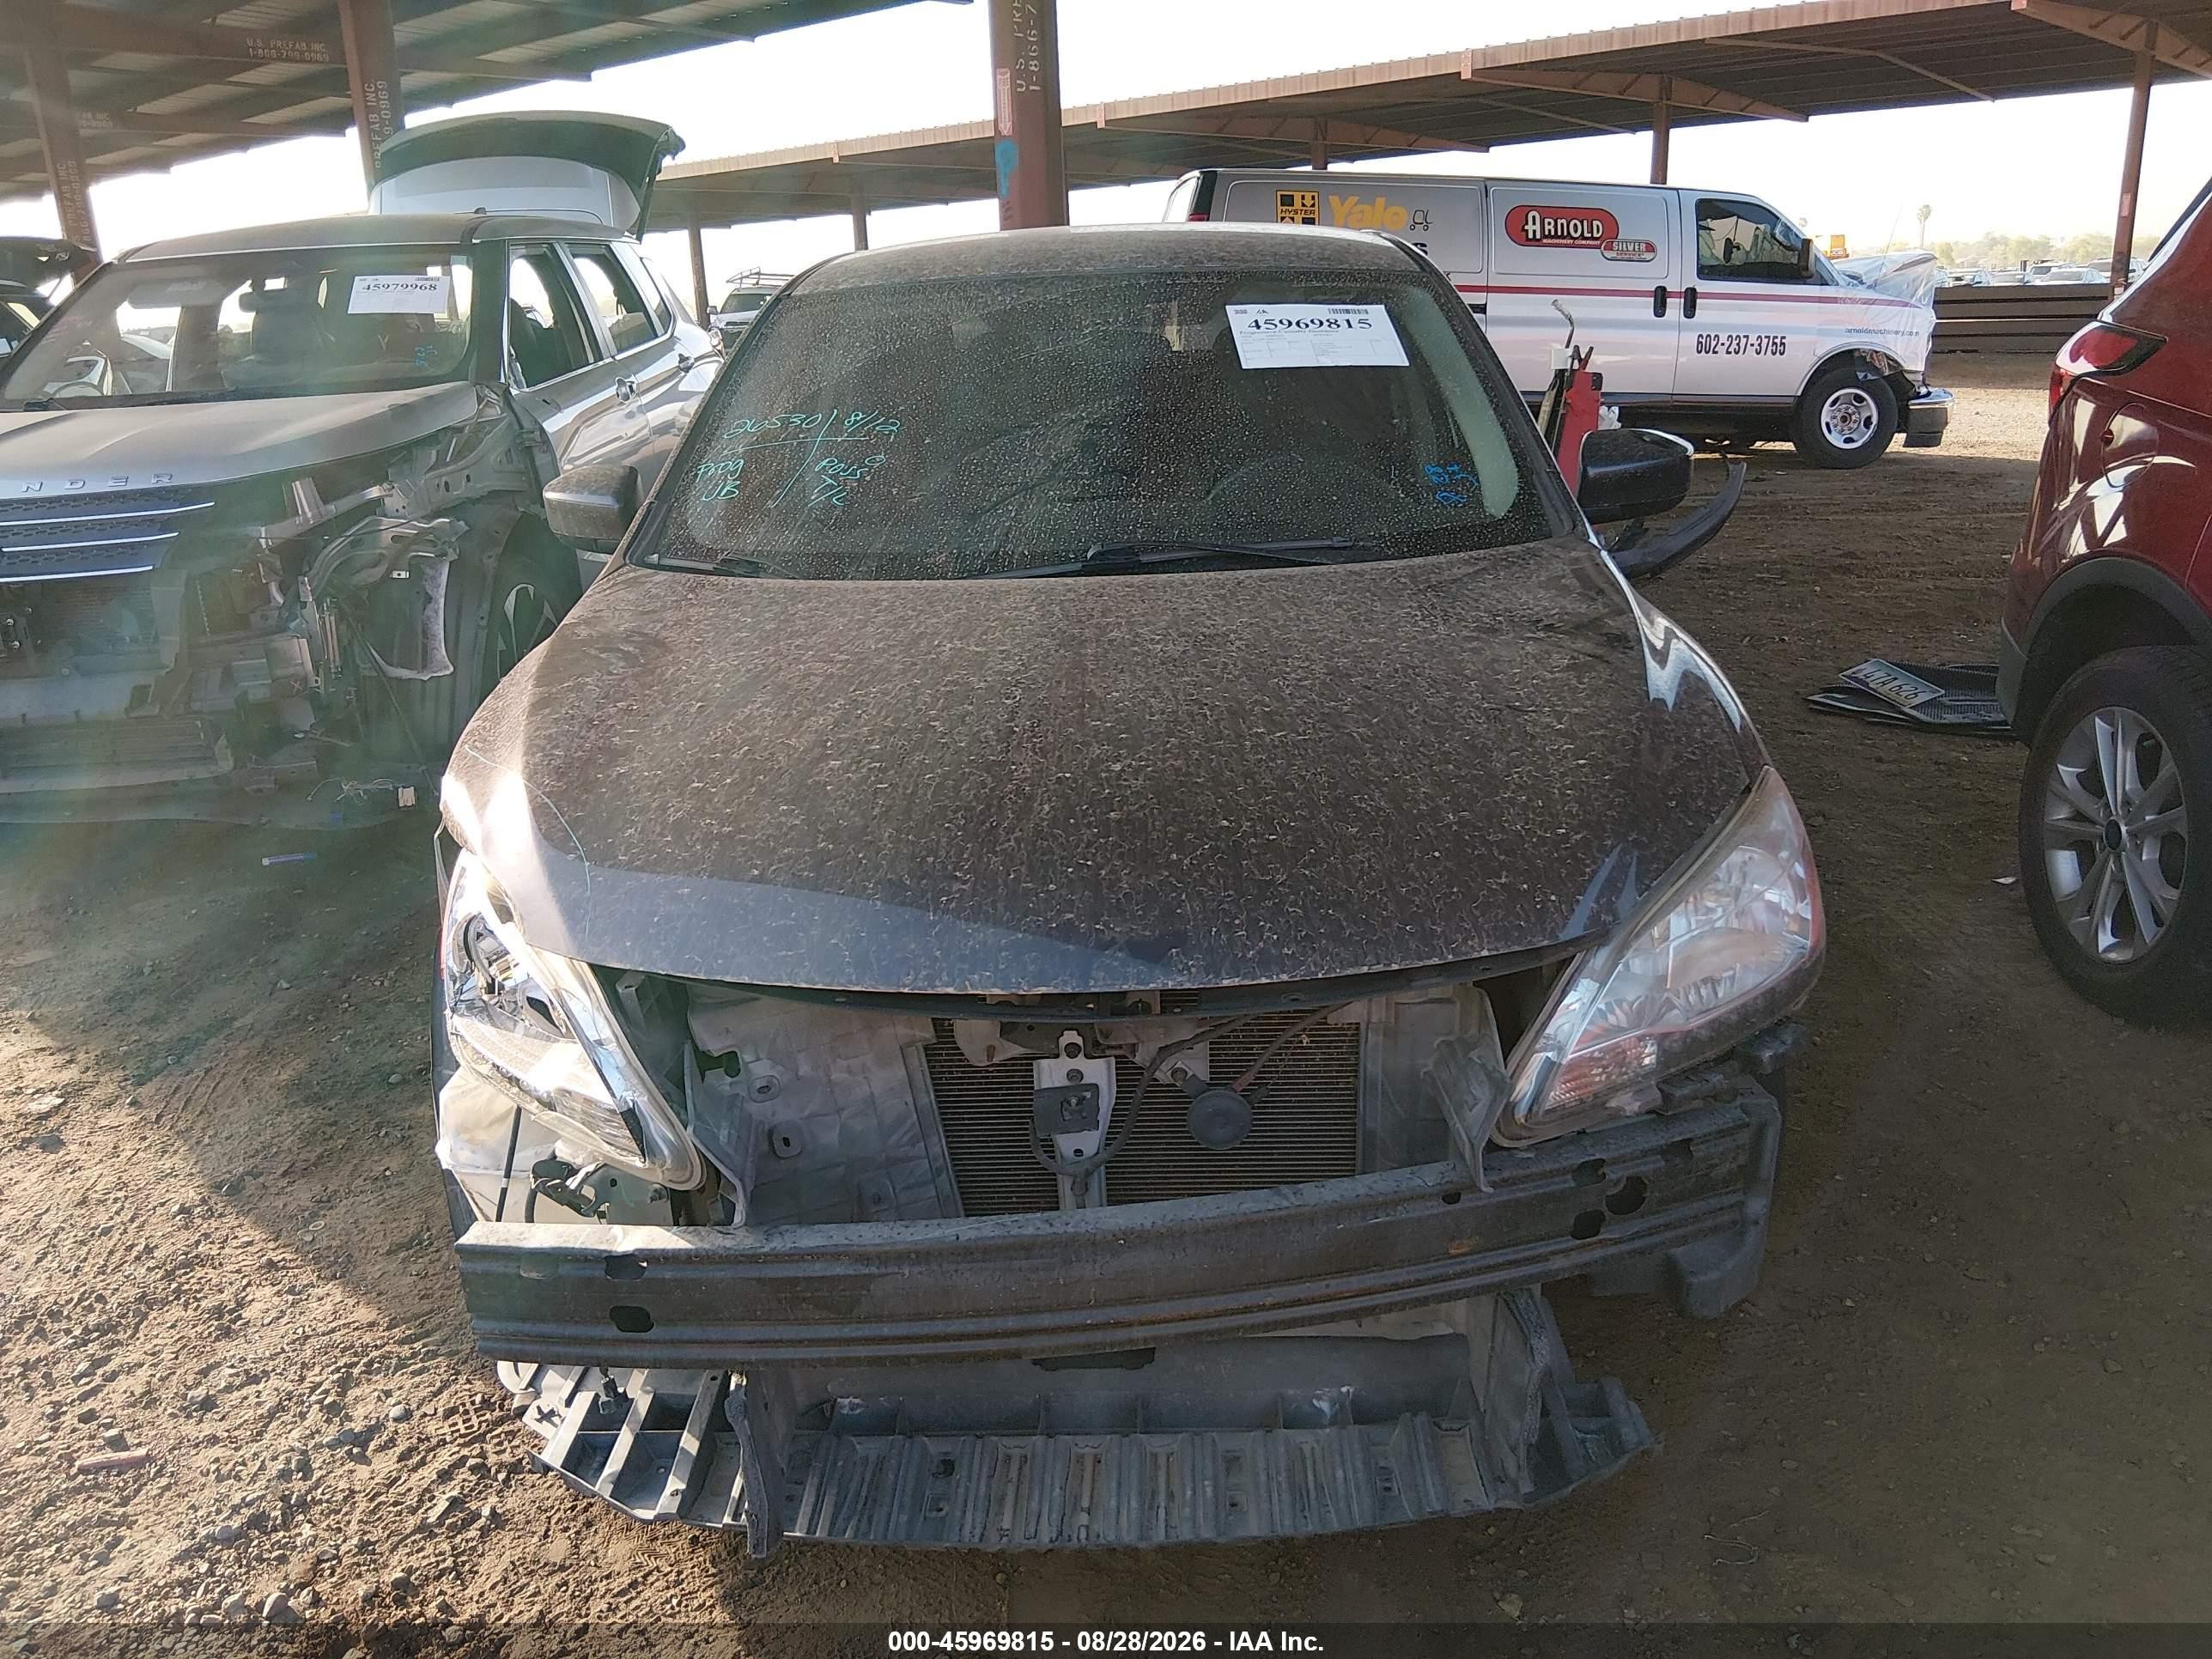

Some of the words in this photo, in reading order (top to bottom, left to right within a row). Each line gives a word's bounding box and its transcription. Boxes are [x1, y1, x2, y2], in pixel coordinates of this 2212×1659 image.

[1025, 4, 1041, 90] 1-866-7
[1015, 52, 1026, 92] U.S.
[1525, 210, 1603, 240] ARNOLD
[1613, 241, 1646, 252] SILVER
[1248, 318, 1373, 330] 45969815
[1696, 333, 1787, 356] 602-237-3755
